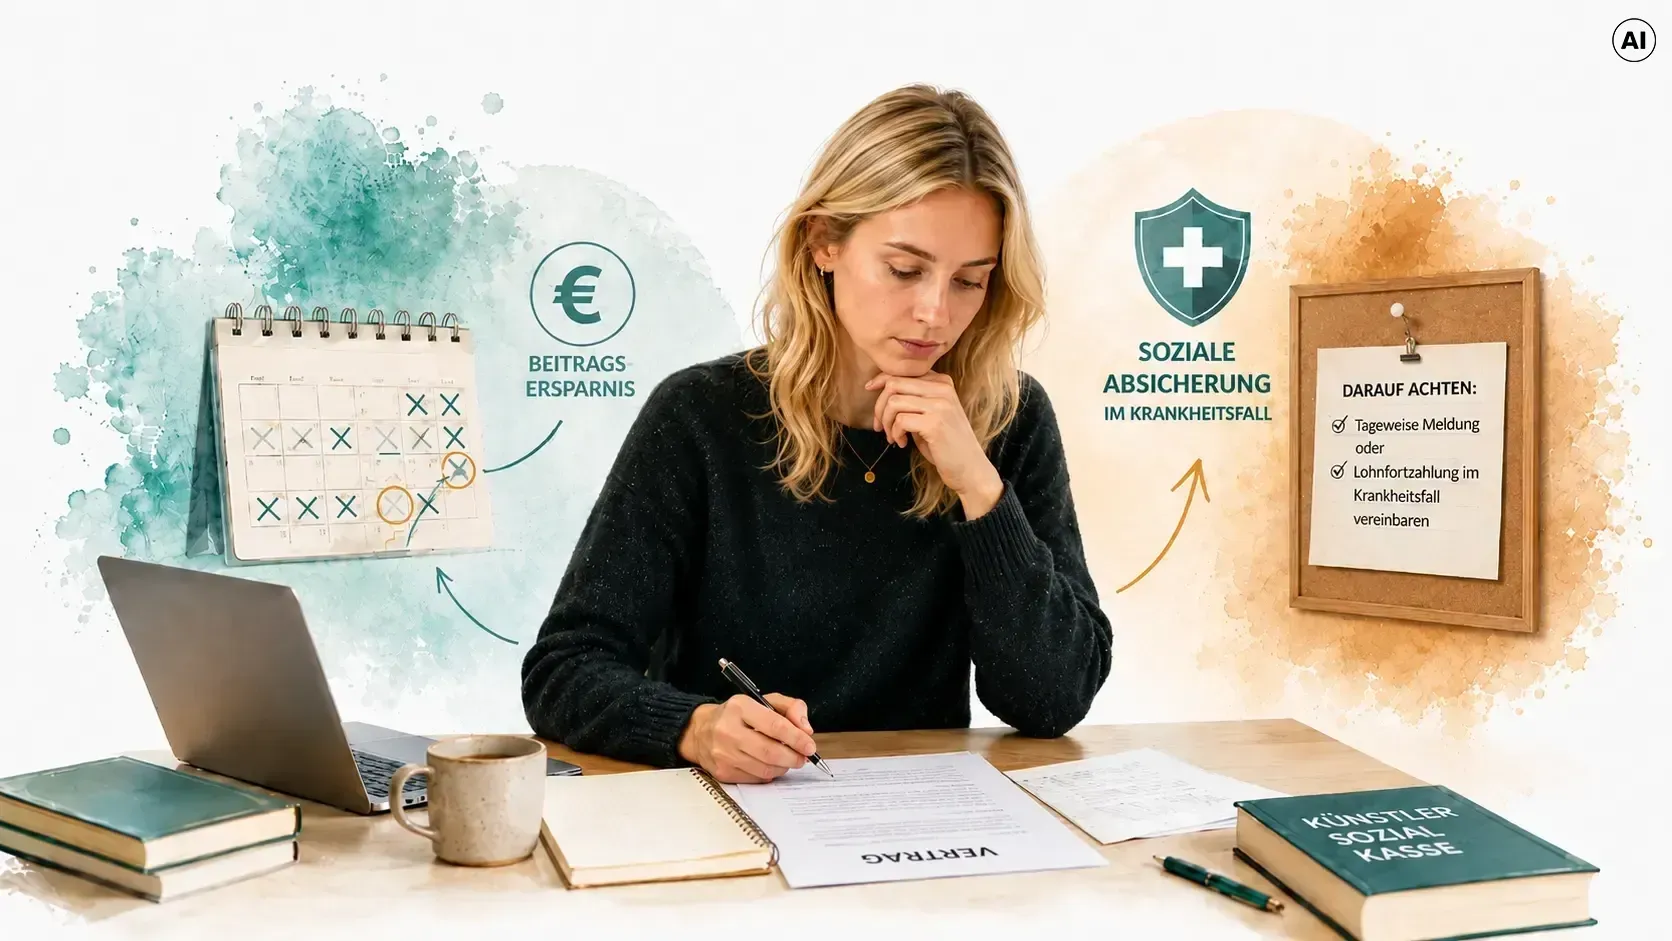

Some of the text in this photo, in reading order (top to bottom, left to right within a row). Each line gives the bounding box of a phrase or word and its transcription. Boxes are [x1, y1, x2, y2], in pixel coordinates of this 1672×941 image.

[1342, 380, 1478, 398] DARAUF ACHTEN:
[1354, 417, 1481, 434] Tageweise Meldung
[1355, 441, 1385, 455] oder
[1353, 464, 1480, 482] Lohnfortzahlung im
[1353, 488, 1441, 504] Krankheitsfall
[1353, 512, 1430, 528] vereinbaren
[1302, 806, 1460, 829] KÜNSTLER
[1328, 825, 1446, 846] SOZIAL
[860, 846, 999, 865] VERTRAG
[1353, 841, 1465, 863] KASSE
